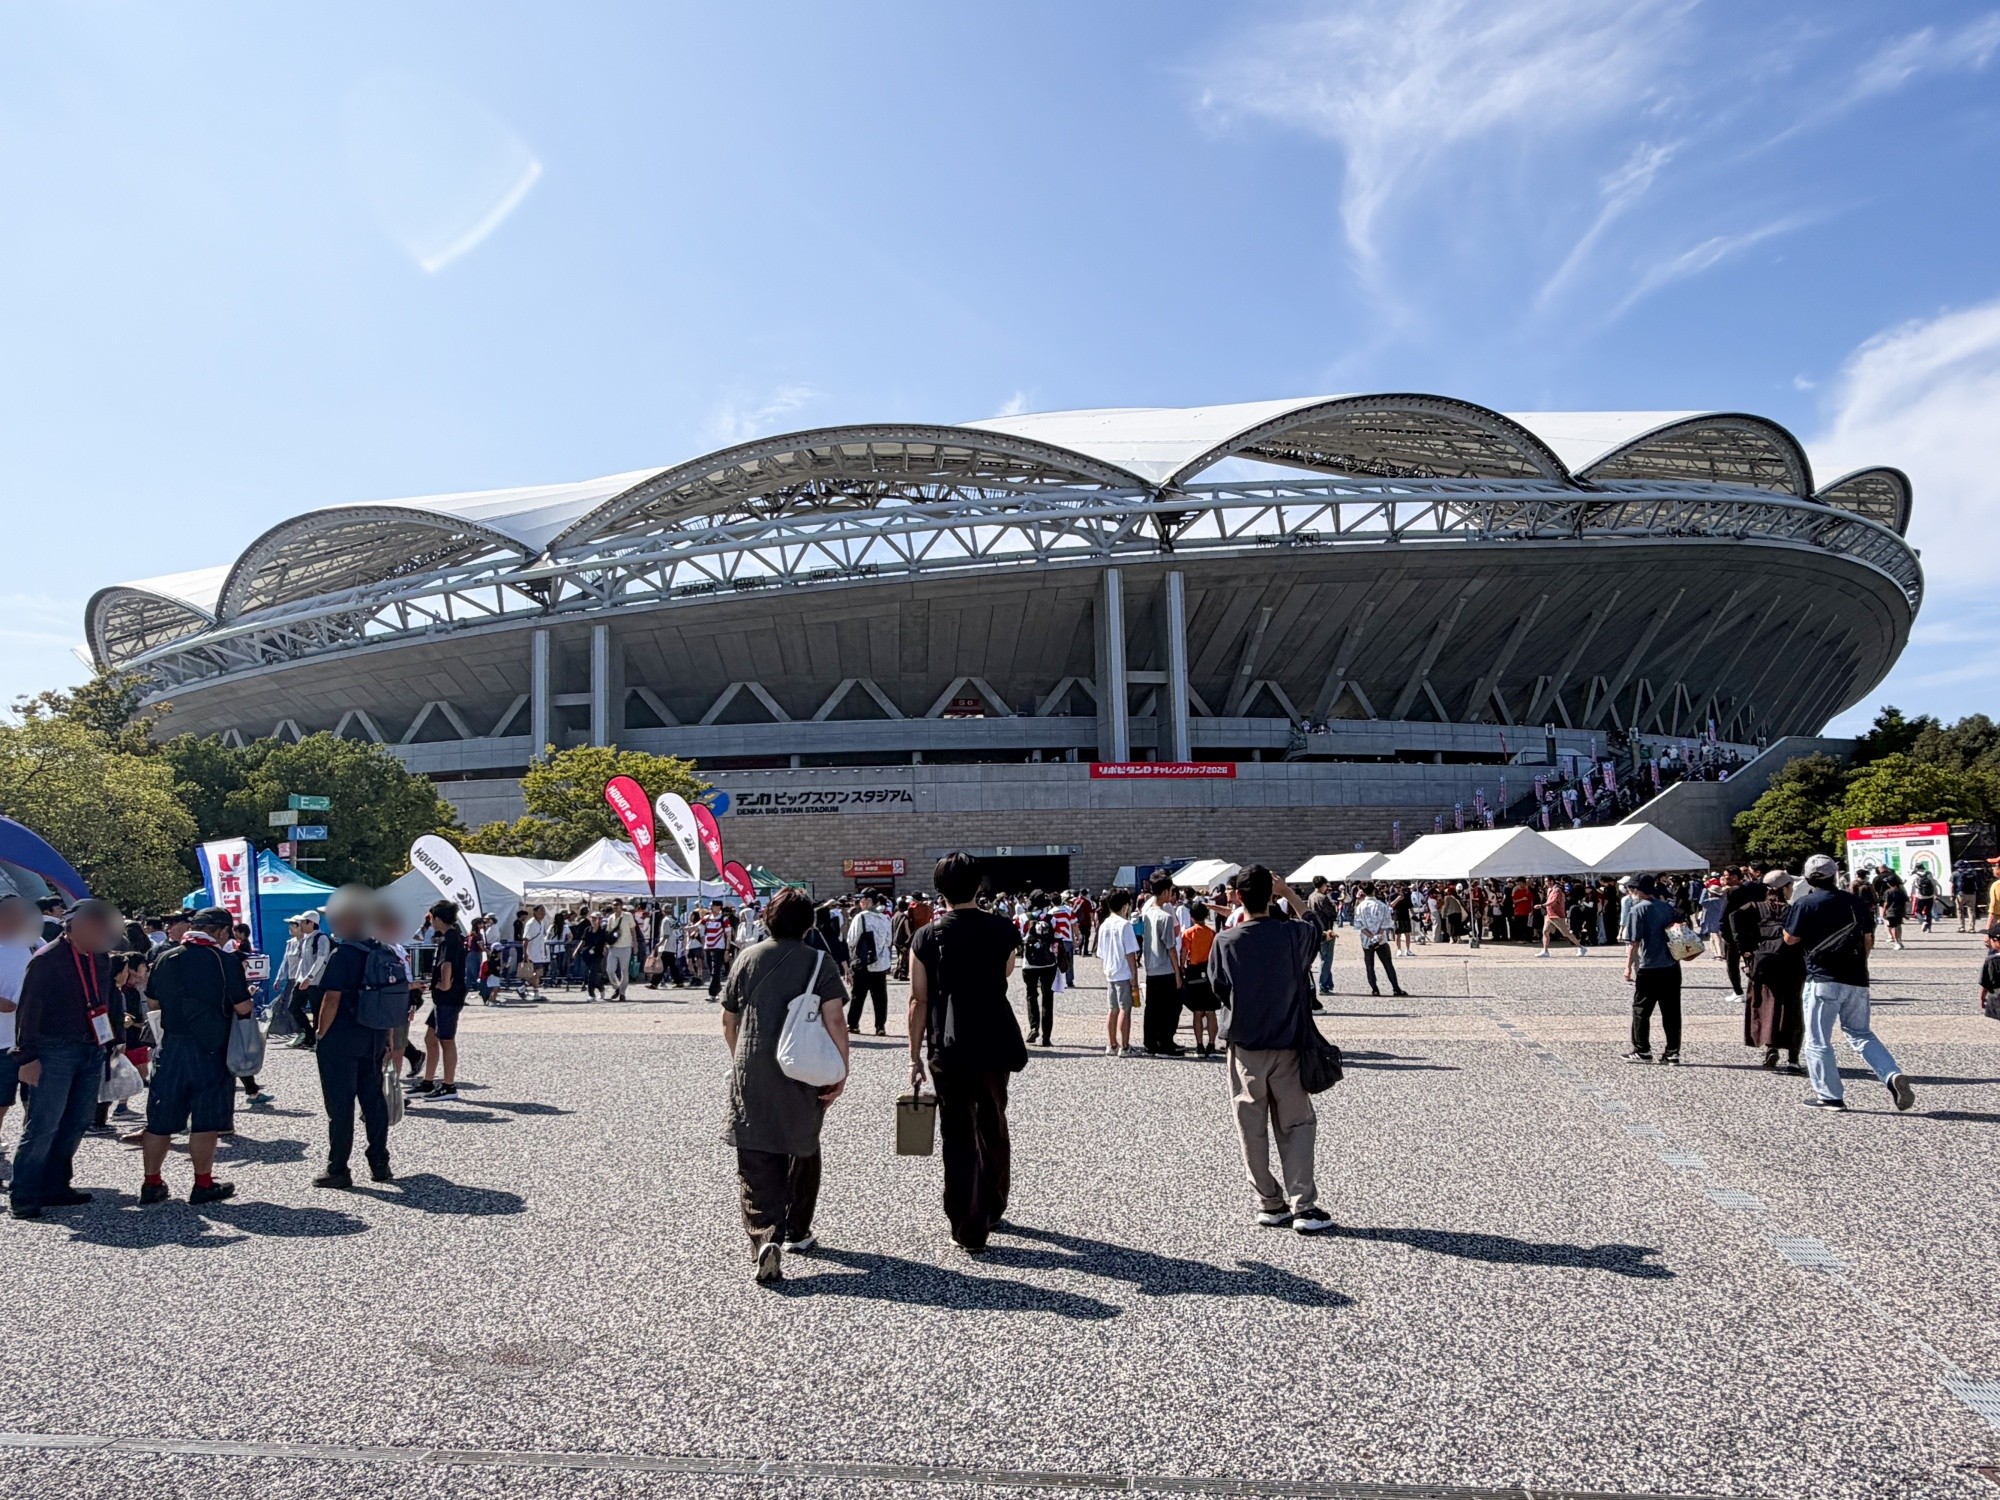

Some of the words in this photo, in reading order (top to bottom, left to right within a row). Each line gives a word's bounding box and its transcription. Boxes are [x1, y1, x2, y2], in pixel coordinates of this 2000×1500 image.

[300, 797, 310, 808] E
[736, 808, 764, 816] DENKA
[765, 806, 779, 815] BIG
[780, 806, 804, 814] SWAN
[805, 806, 839, 814] STADIUM
[296, 828, 306, 840] N
